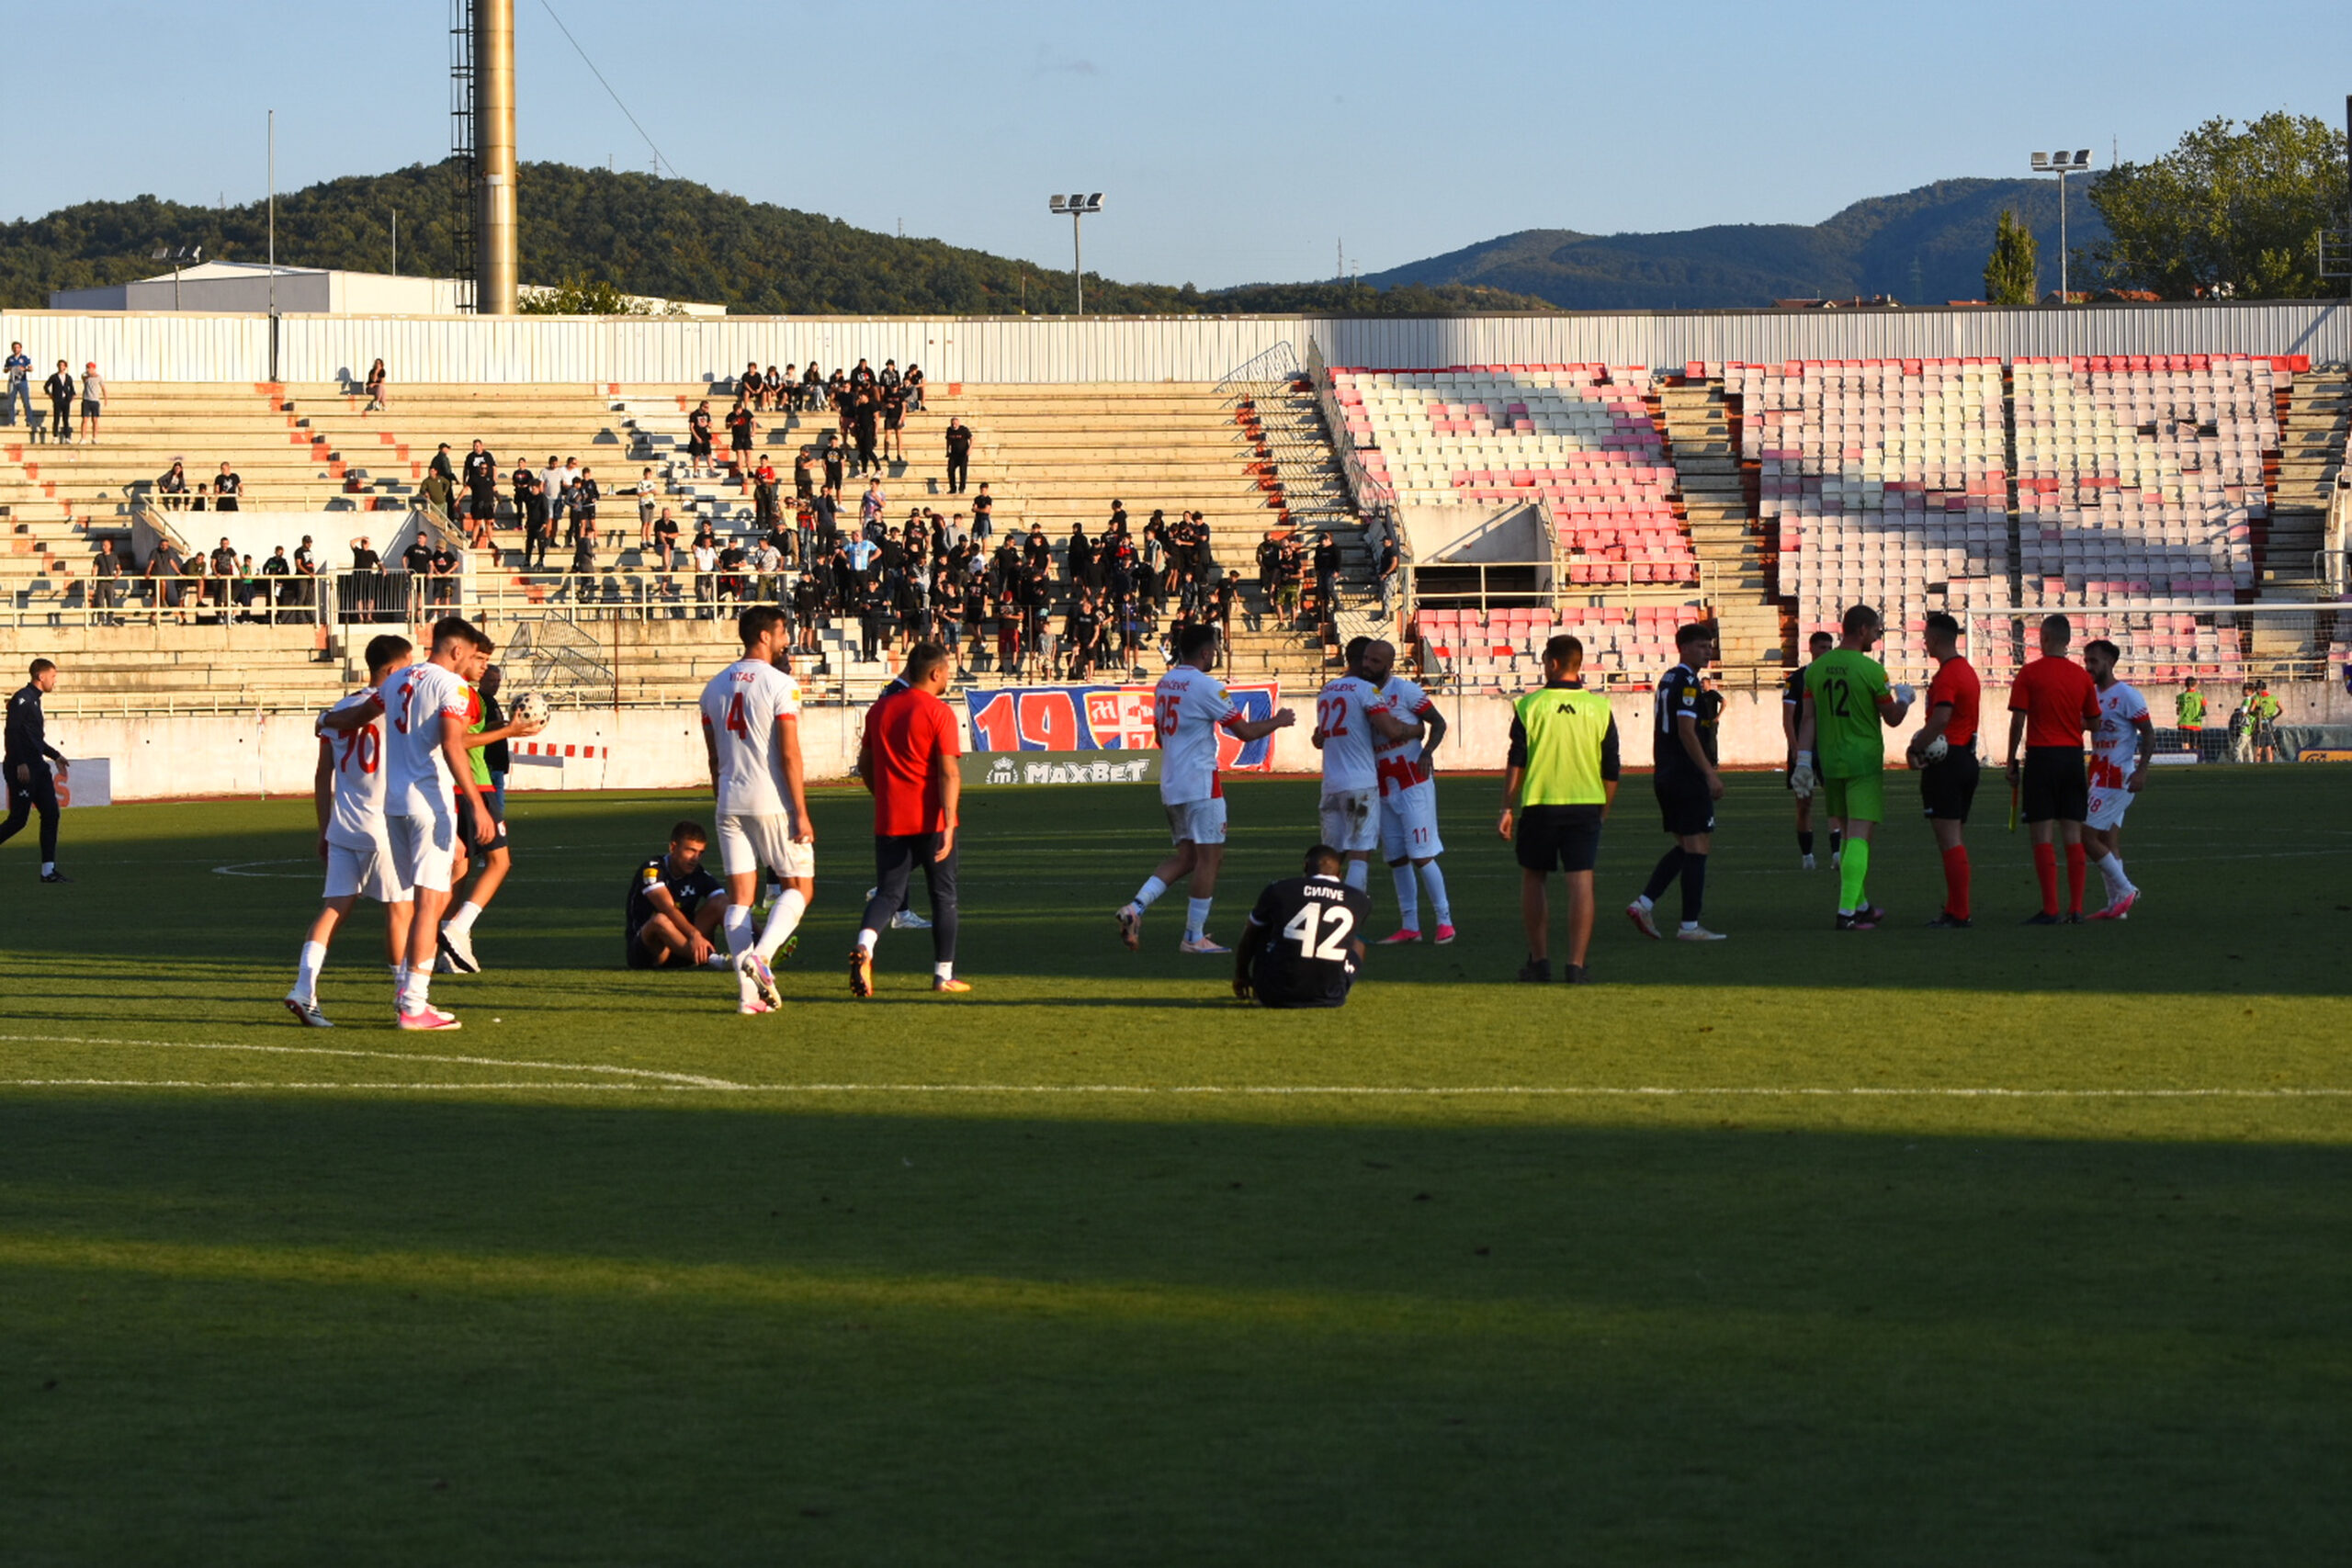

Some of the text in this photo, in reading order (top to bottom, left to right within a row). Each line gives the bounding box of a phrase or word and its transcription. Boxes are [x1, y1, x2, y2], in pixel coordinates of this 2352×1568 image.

[729, 671, 755, 682] VITAS
[1823, 678, 1850, 717] 12
[394, 682, 413, 734] 3
[727, 692, 747, 739] 4
[974, 691, 1078, 751] 19
[1317, 696, 1348, 738] 22
[338, 724, 379, 774] 70
[1412, 827, 1427, 843] 11
[1283, 901, 1353, 961] 42
